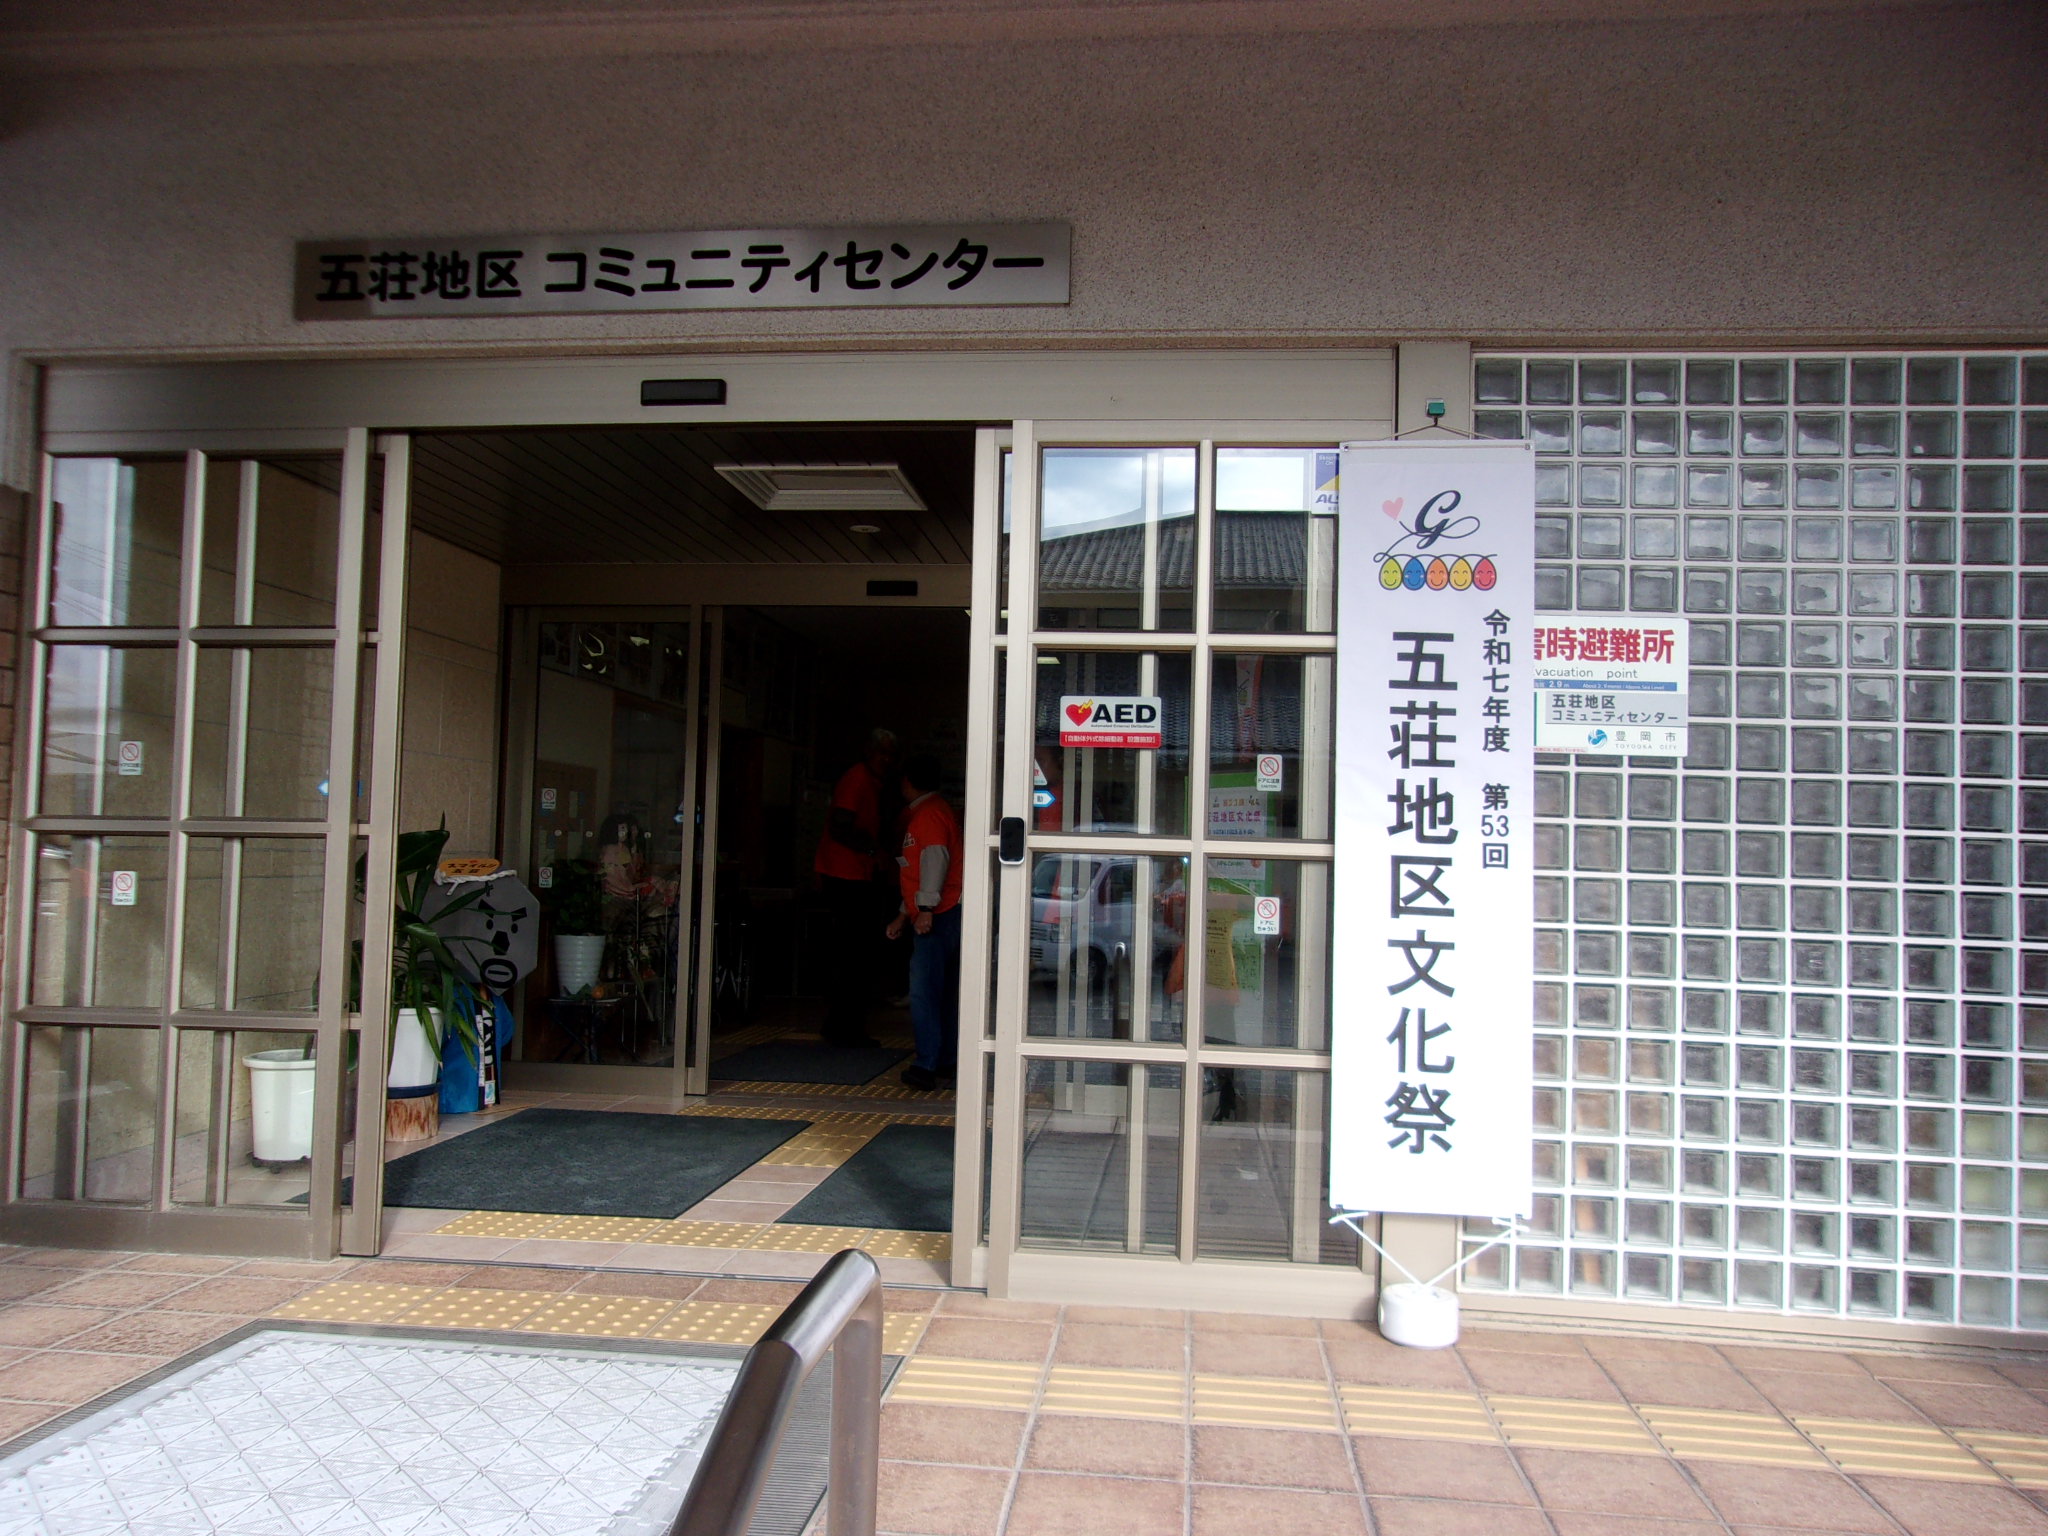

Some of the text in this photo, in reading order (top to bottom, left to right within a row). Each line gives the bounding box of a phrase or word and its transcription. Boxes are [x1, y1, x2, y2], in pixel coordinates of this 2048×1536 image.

[315, 237, 1045, 303] 五荘地区 コミュニティセンター
[1315, 493, 1339, 504] AL
[1535, 667, 1638, 679] vacuation point
[1552, 694, 1616, 709] 五荘地区
[1091, 703, 1157, 723] AED
[1552, 710, 1678, 724] コミュニティセンター
[1480, 608, 1512, 869] 令和七年度 第53回
[1384, 631, 1459, 1155] 五荘地区文化祭
